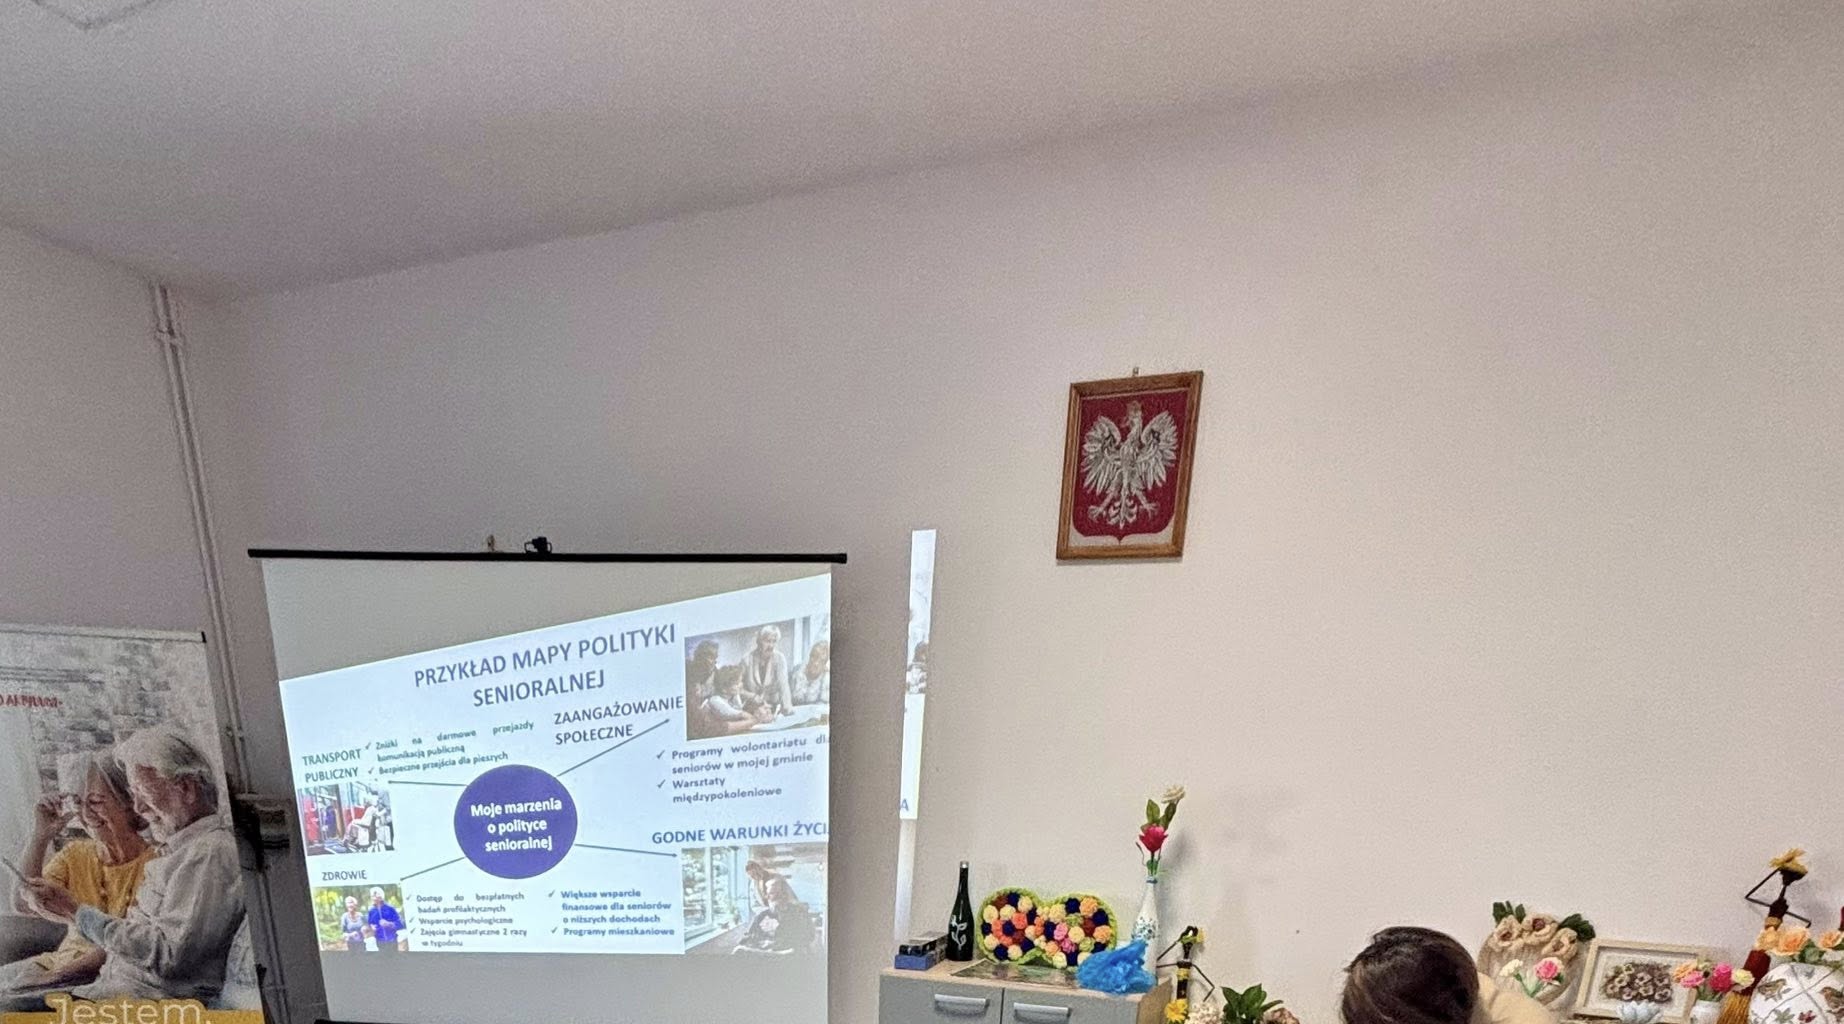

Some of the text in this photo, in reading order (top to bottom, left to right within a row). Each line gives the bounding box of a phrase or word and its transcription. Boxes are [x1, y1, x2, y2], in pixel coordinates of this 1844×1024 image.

[414, 623, 677, 688] PRZYKŁAD MAPY POLITYKI
[472, 669, 606, 707] SENIORALNEJ
[553, 695, 684, 725] ZAANGAŻOWANIE
[376, 720, 535, 750] Zniżki na darmowe przejazdy
[554, 724, 634, 746] SPOŁECZNE
[377, 745, 466, 763] komunikacją publiczną
[671, 733, 832, 761] Programy wolontariatu dl
[302, 748, 362, 768] TRANSPORT
[379, 751, 509, 775] Bezpieczne przejścia dla pieszych
[672, 761, 722, 775] seniorów
[737, 755, 770, 769] mojej
[772, 751, 814, 768] gminie
[304, 767, 359, 784] PUBLICZNY
[672, 776, 726, 790] Warsztaty
[673, 786, 783, 804] międzypokoleniowe
[470, 797, 562, 818] Moje marzenia
[487, 818, 548, 835] o polityce
[651, 819, 830, 845] GODNE WARUNKI ŻYCI
[485, 836, 553, 852] senioralnej
[322, 870, 367, 882] ZDROWIE
[416, 892, 525, 903] Dostęp do bezpłatnych
[560, 888, 641, 901] Większe wsparcie
[562, 900, 672, 912] finansowe dla seniorów
[418, 917, 513, 926] Wsparcie psychologiczne
[571, 914, 607, 925] niższych
[609, 914, 661, 923] dochodach
[420, 928, 527, 938] Zajęcia gimnastyczne 2 razy
[563, 926, 675, 937] Programy mieszkaniowe
